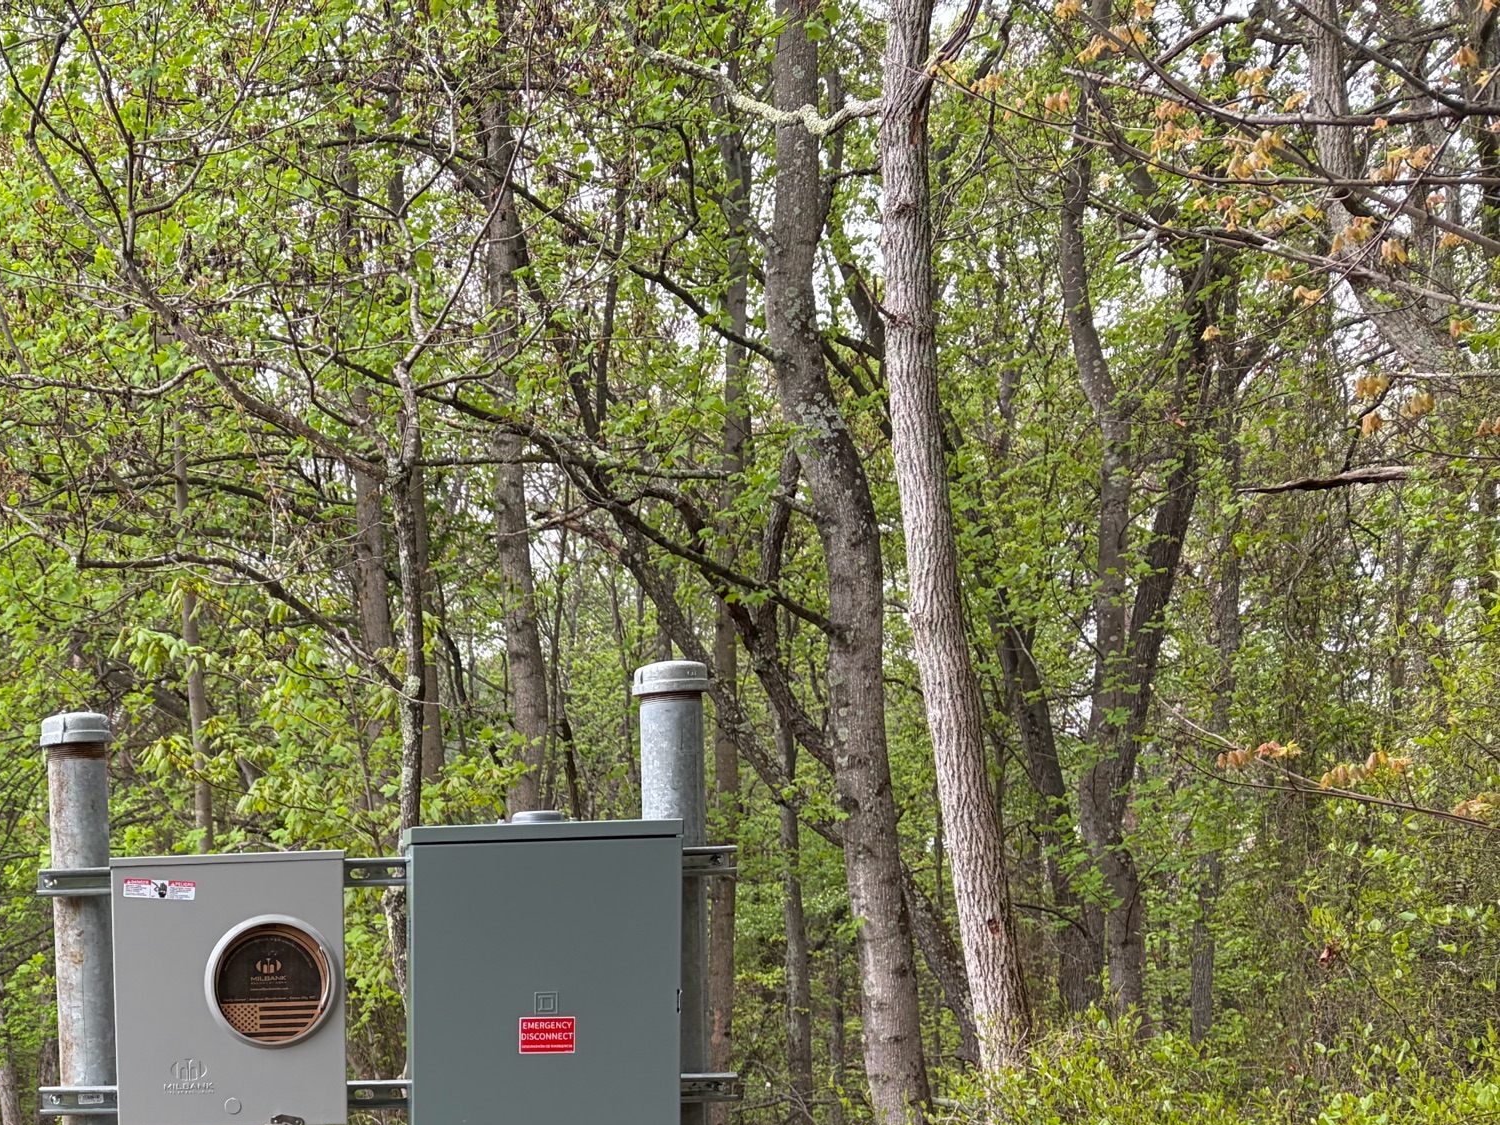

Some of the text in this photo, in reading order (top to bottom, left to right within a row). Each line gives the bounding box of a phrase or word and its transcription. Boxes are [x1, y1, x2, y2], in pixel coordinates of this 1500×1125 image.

[522, 1021, 573, 1030] EMERGENCY
[521, 1032, 574, 1041] DISCONNECT
[163, 1082, 214, 1090] MILBANK
